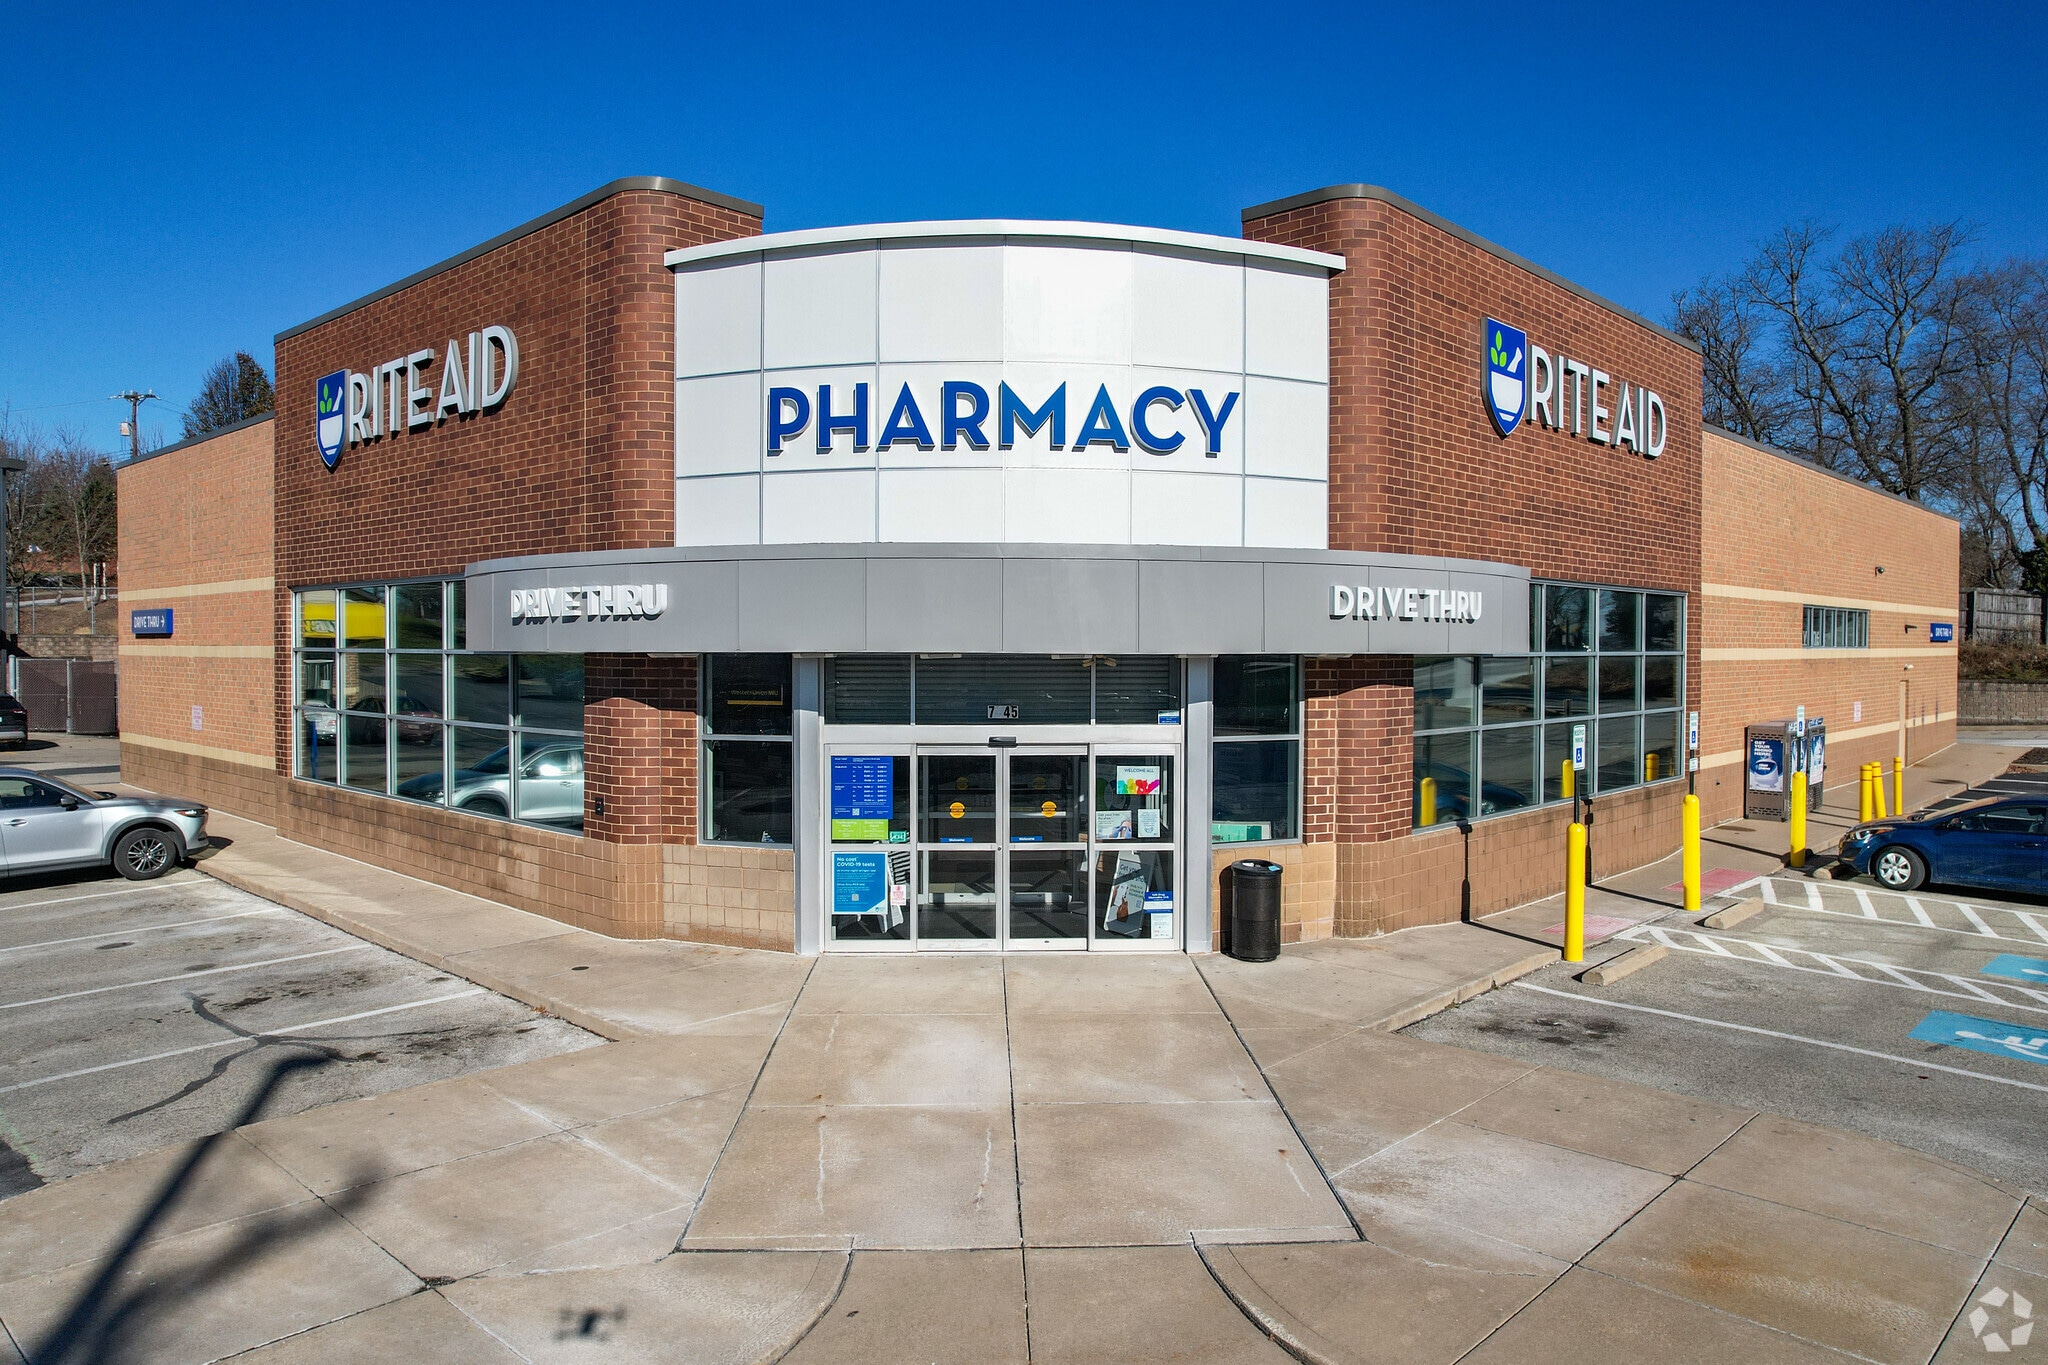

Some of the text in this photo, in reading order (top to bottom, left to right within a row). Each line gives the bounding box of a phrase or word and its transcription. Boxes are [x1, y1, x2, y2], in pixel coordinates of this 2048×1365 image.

[348, 325, 519, 443] RITE AID
[1525, 344, 1667, 457] RITE AID
[767, 380, 1240, 458] PHARMACY
[133, 615, 160, 628] DRIVE THRU
[511, 584, 667, 620] DRIVE THRU
[1329, 585, 1482, 621] DRIVE THRU
